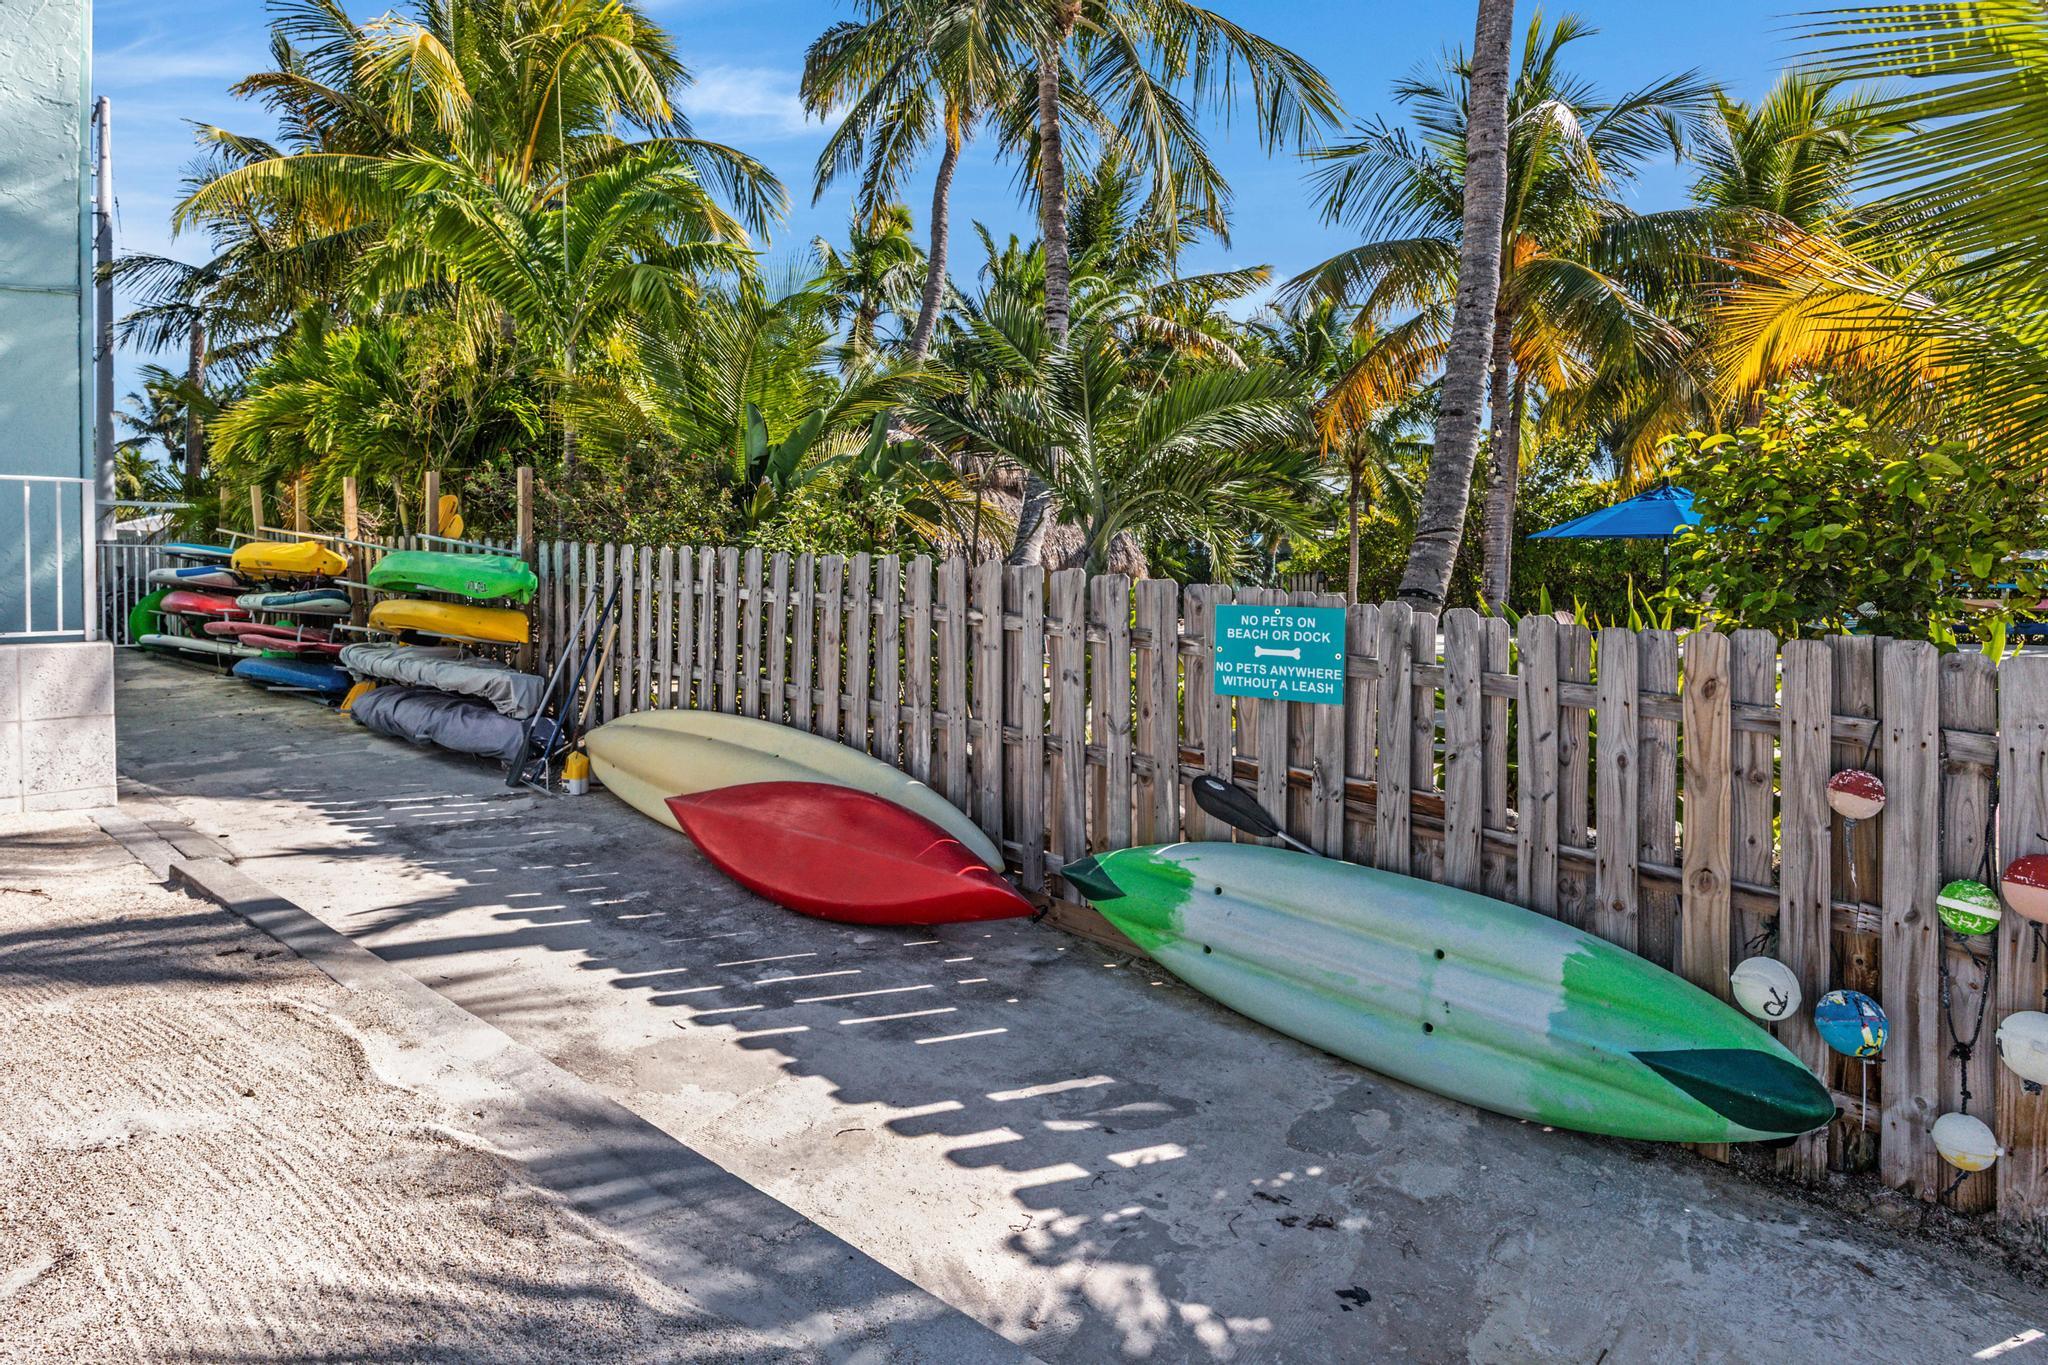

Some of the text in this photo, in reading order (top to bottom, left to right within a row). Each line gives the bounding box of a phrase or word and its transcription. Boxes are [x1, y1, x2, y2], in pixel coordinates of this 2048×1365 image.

[1241, 615, 1316, 628] NO PETS ON
[1227, 628, 1331, 643] BEACH OR DOCK
[1216, 661, 1342, 680] NO PETS ANYWHERE
[1222, 675, 1334, 694] WITHOUT A LEASH
